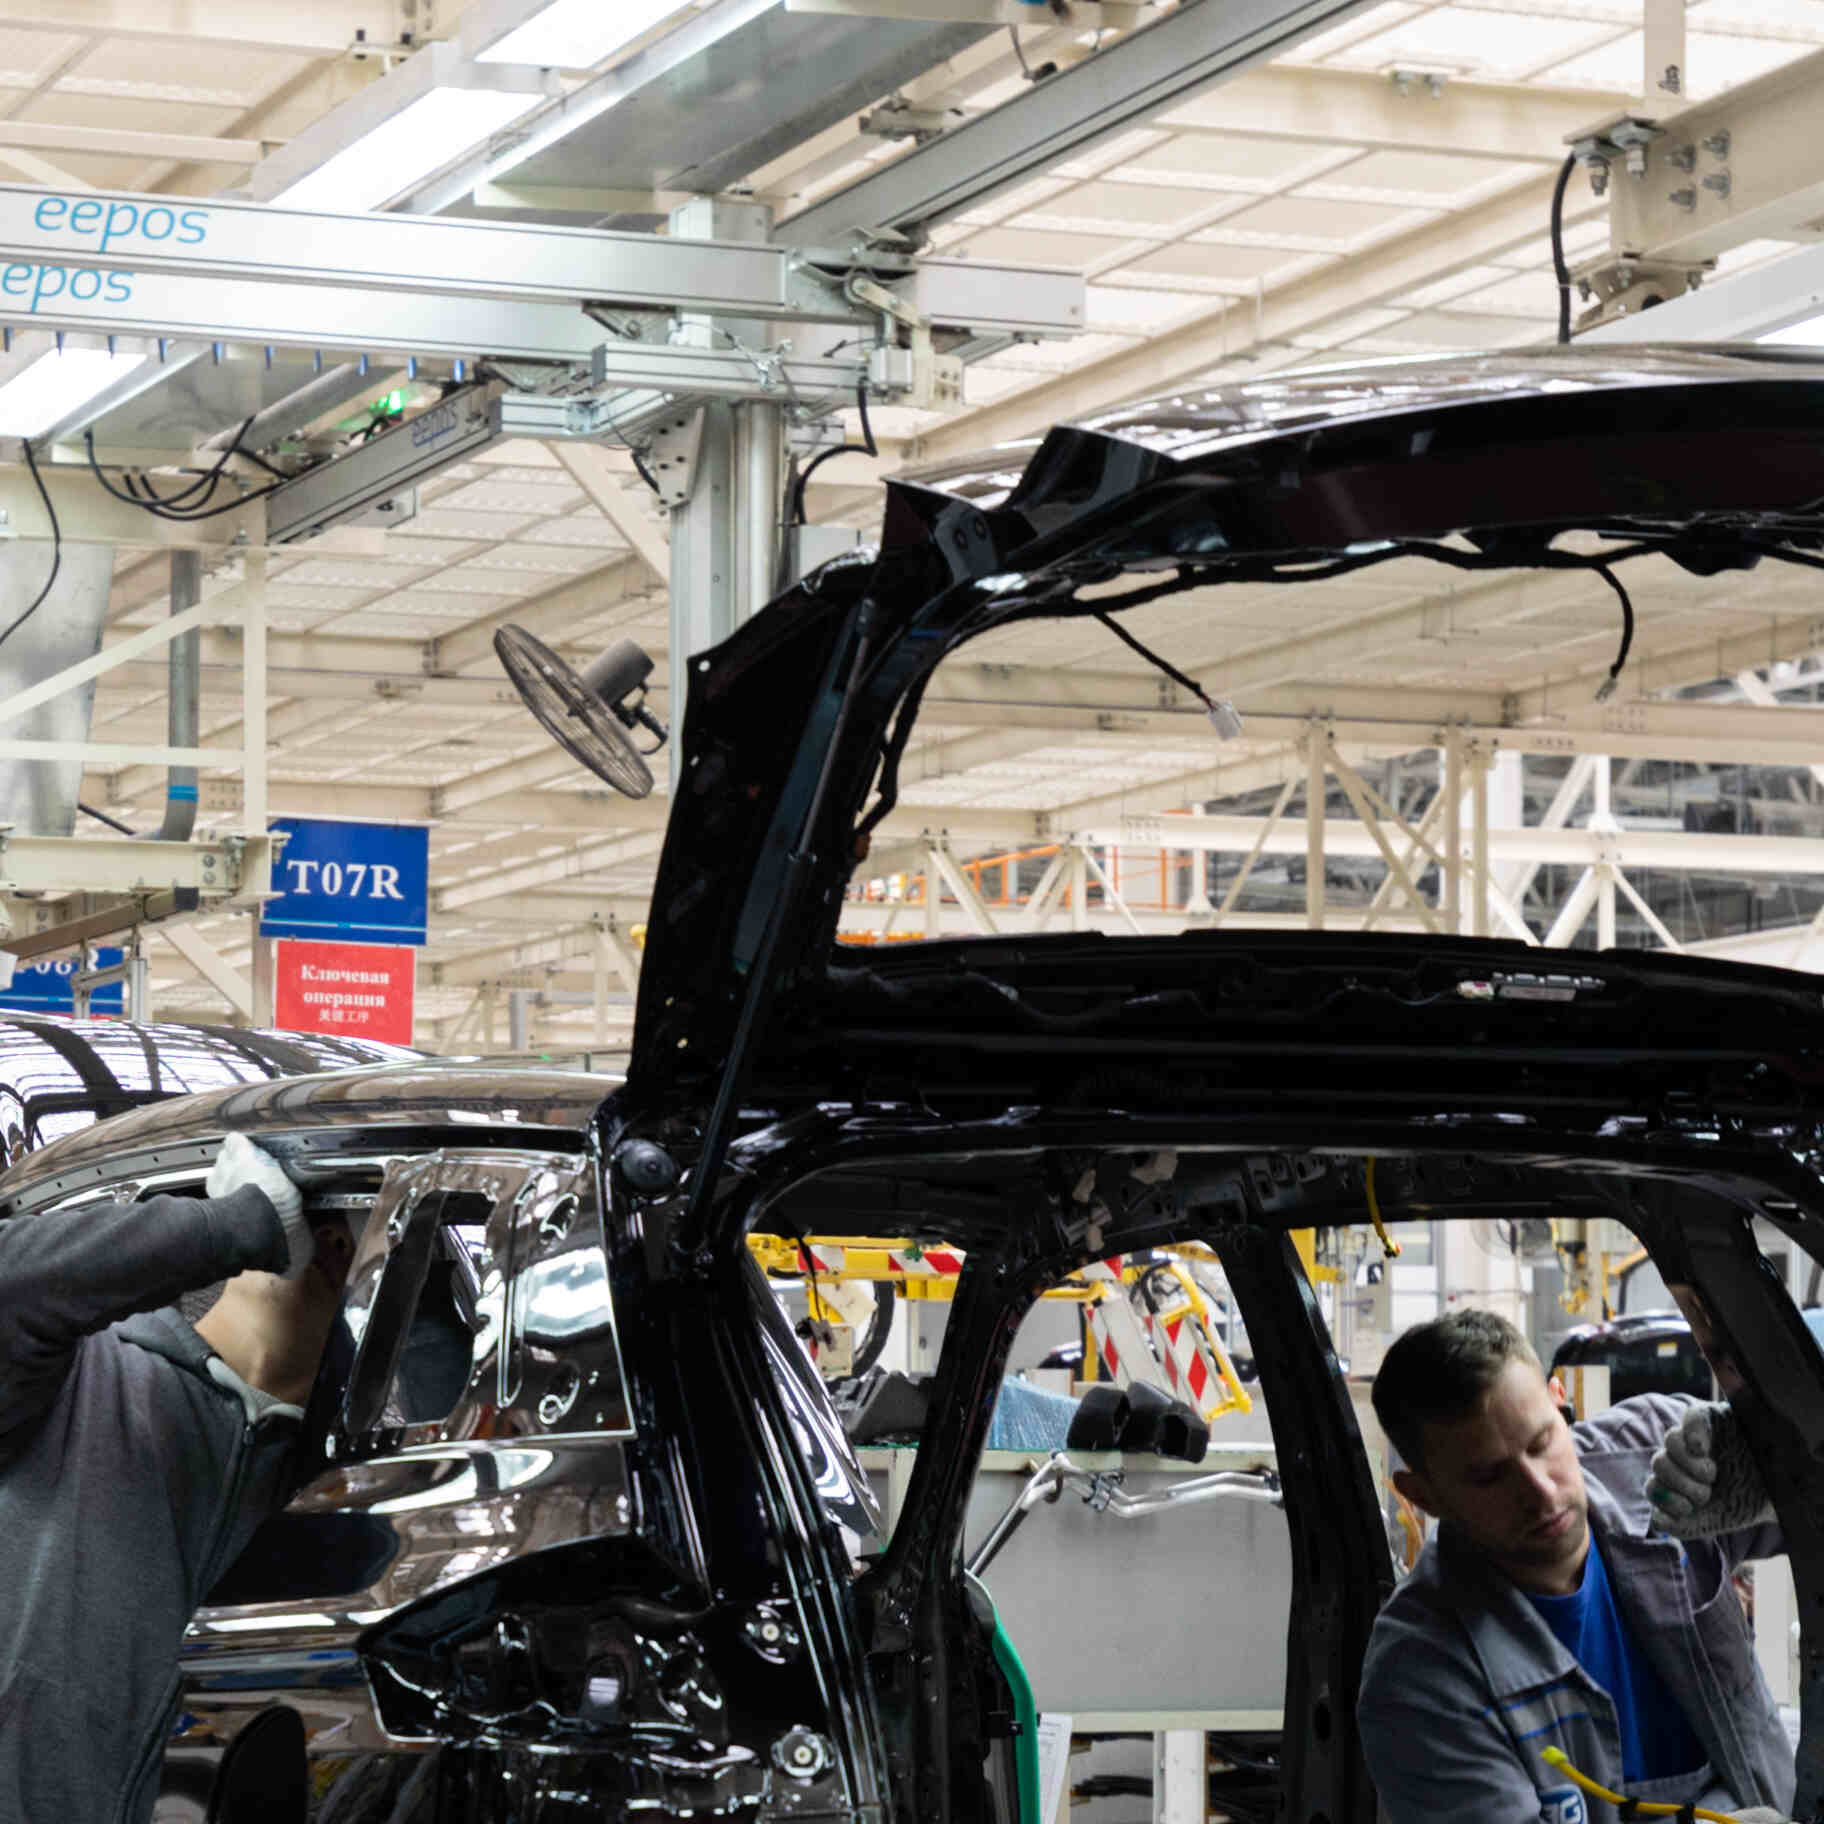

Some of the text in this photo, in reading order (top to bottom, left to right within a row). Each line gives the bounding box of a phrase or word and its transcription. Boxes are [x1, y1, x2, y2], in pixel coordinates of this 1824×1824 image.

[33, 196, 210, 254] eepos
[287, 860, 405, 900] T07R
[300, 964, 390, 985] Ключевая
[303, 991, 385, 1008] операция
